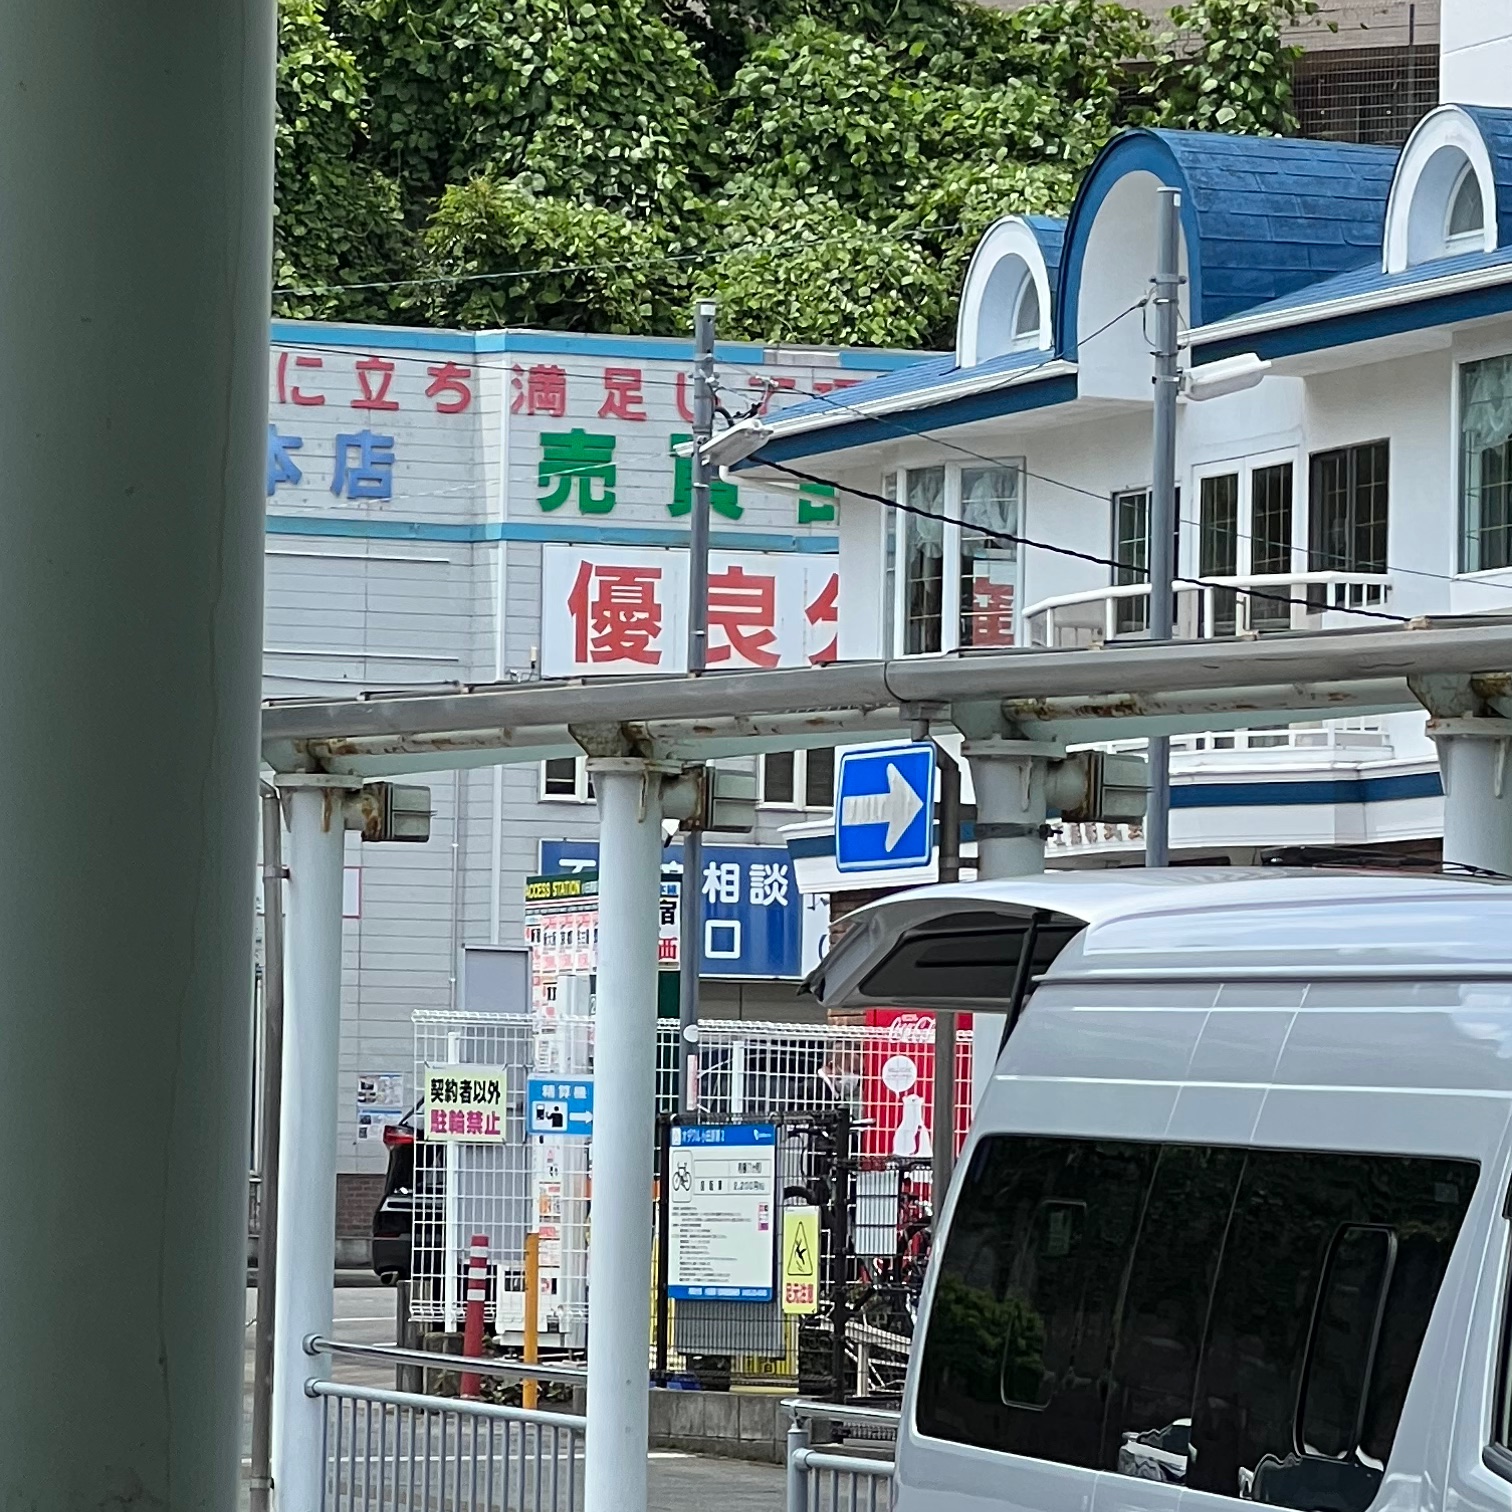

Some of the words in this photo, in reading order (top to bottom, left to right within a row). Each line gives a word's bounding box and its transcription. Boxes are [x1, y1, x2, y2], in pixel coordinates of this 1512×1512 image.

[430, 1078, 501, 1105] 契約者以外
[430, 1109, 501, 1136] 駐輪禁止
